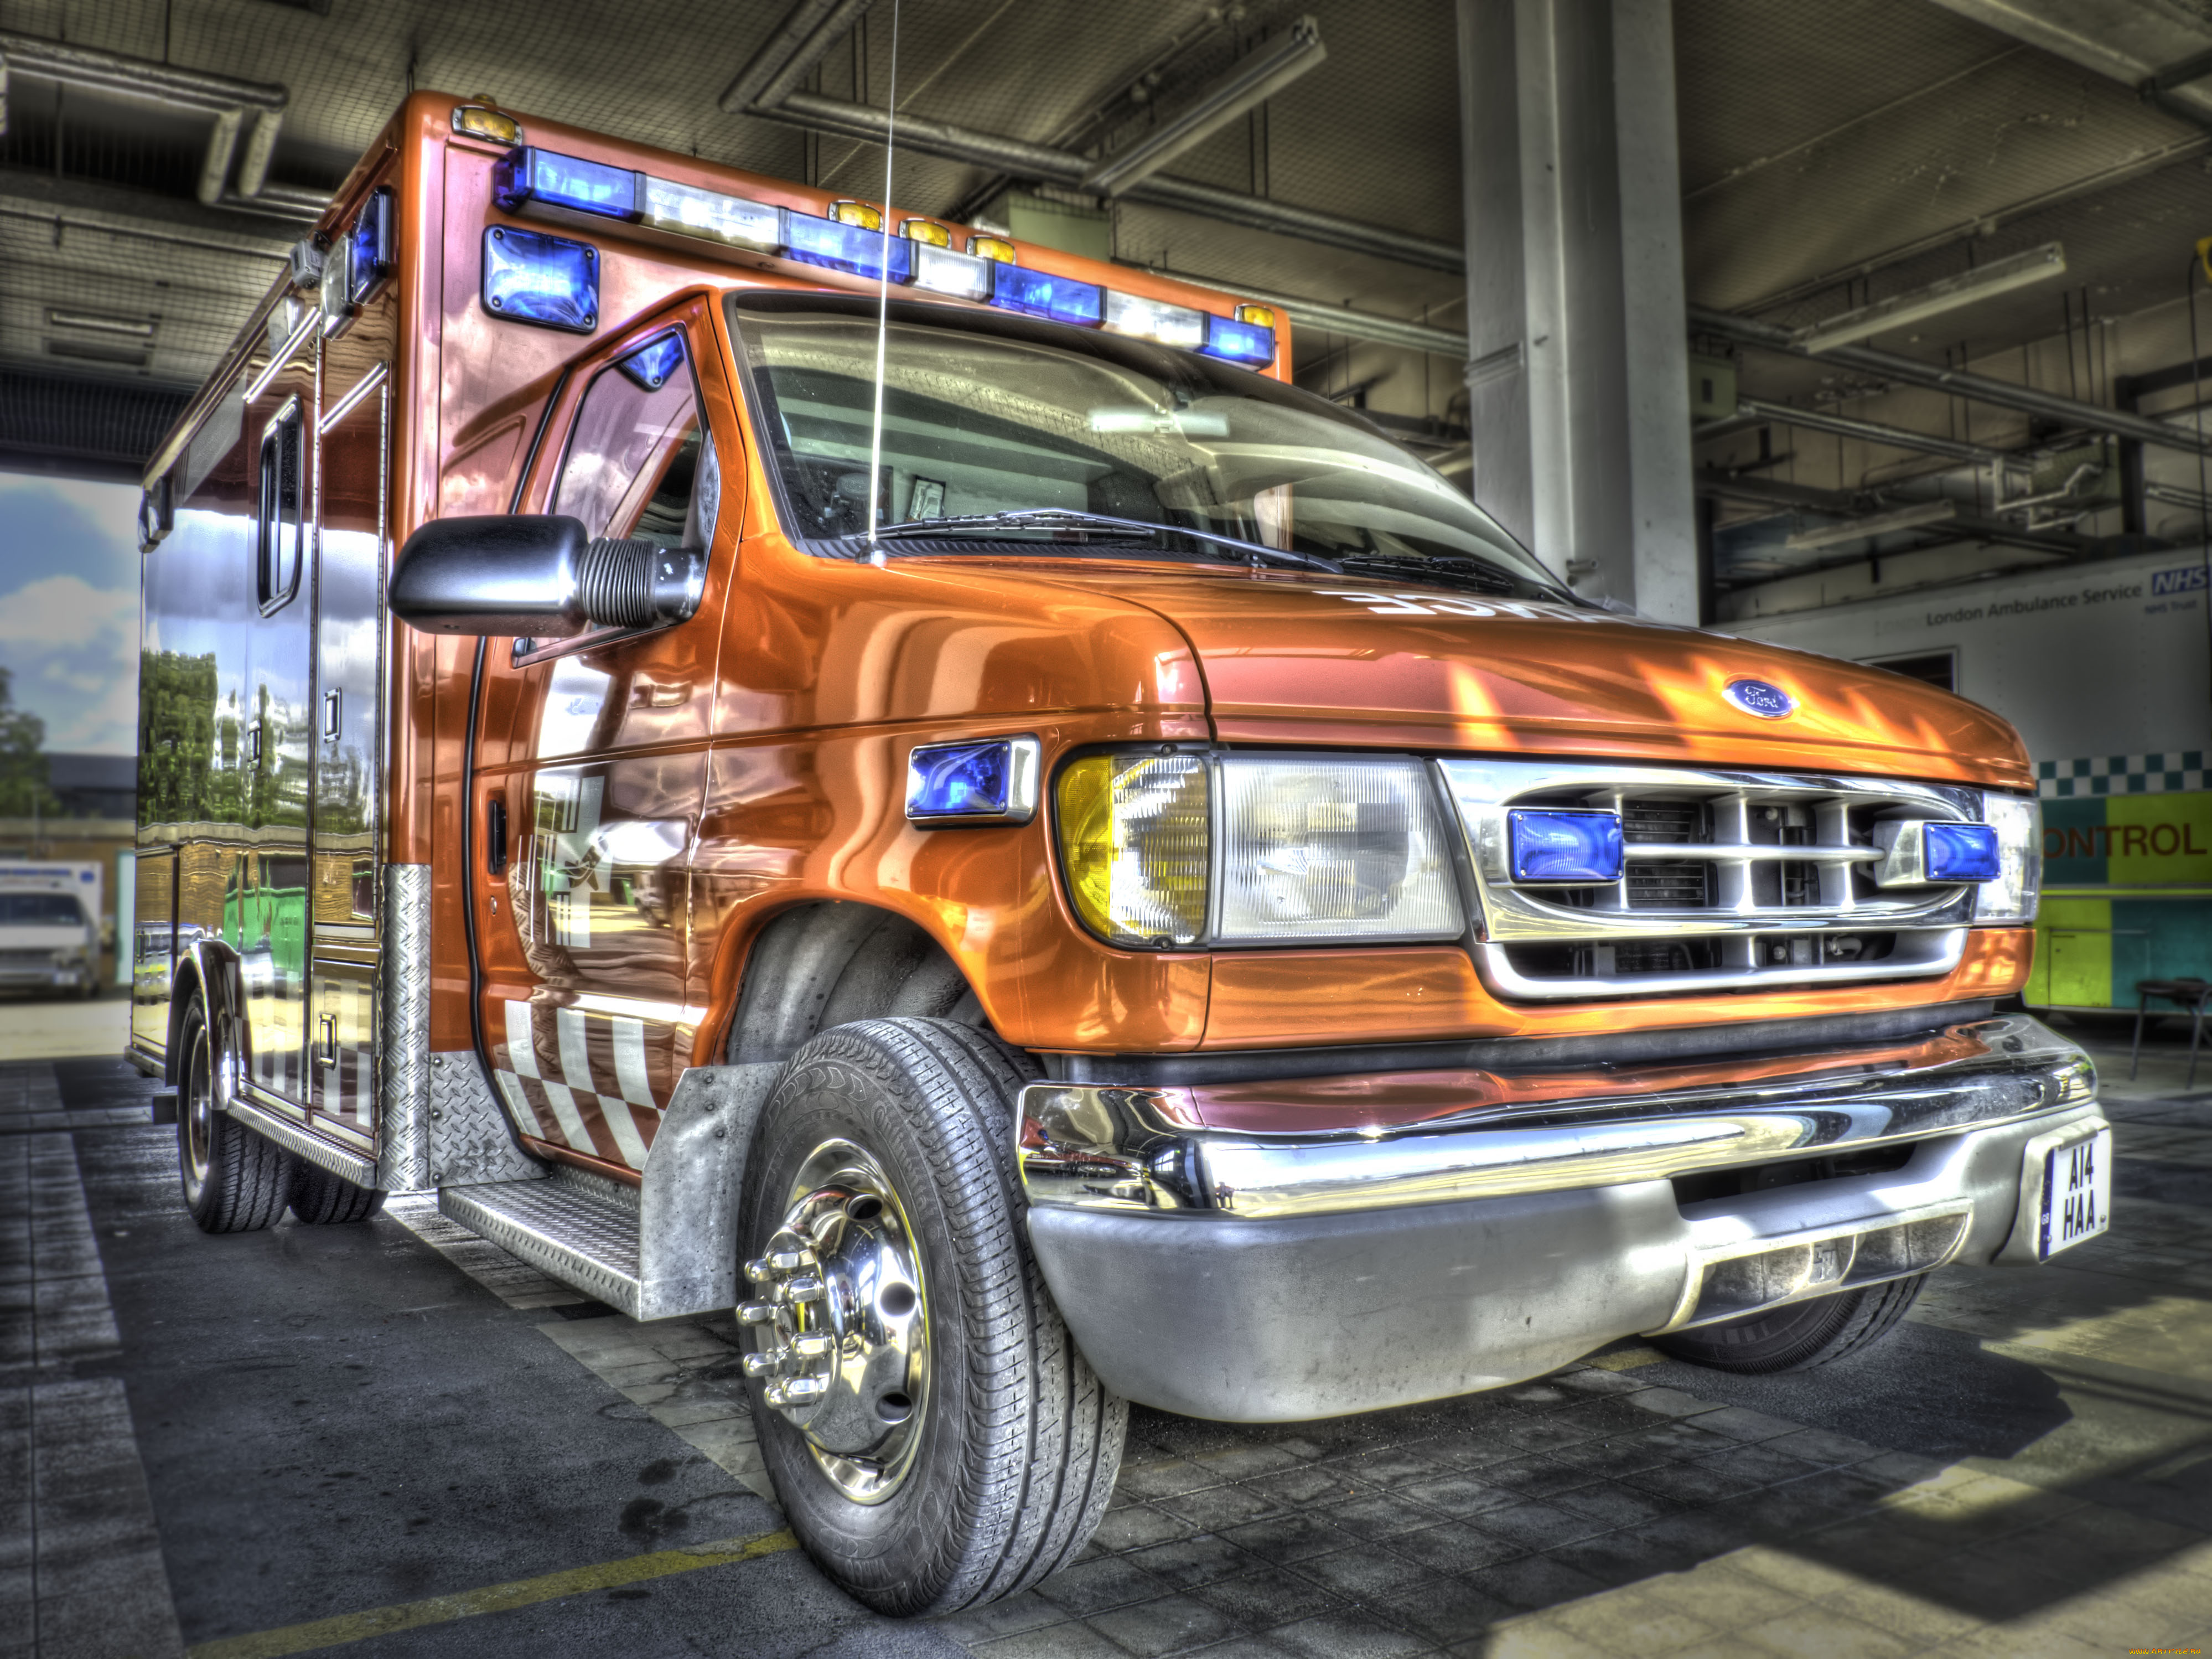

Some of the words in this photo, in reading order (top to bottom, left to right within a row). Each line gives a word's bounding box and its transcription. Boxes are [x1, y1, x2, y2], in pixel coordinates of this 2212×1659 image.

[2154, 567, 2206, 594] NHS
[1926, 607, 1982, 626] London
[1987, 594, 2078, 617] Ambulance
[2082, 585, 2142, 604] Service
[2144, 602, 2167, 614] NHS
[2170, 599, 2197, 611] Trust
[1745, 686, 1779, 709] Ford
[2043, 823, 2208, 859] ONTROL
[2069, 1143, 2094, 1192] A14
[2063, 1189, 2095, 1241] HAA
